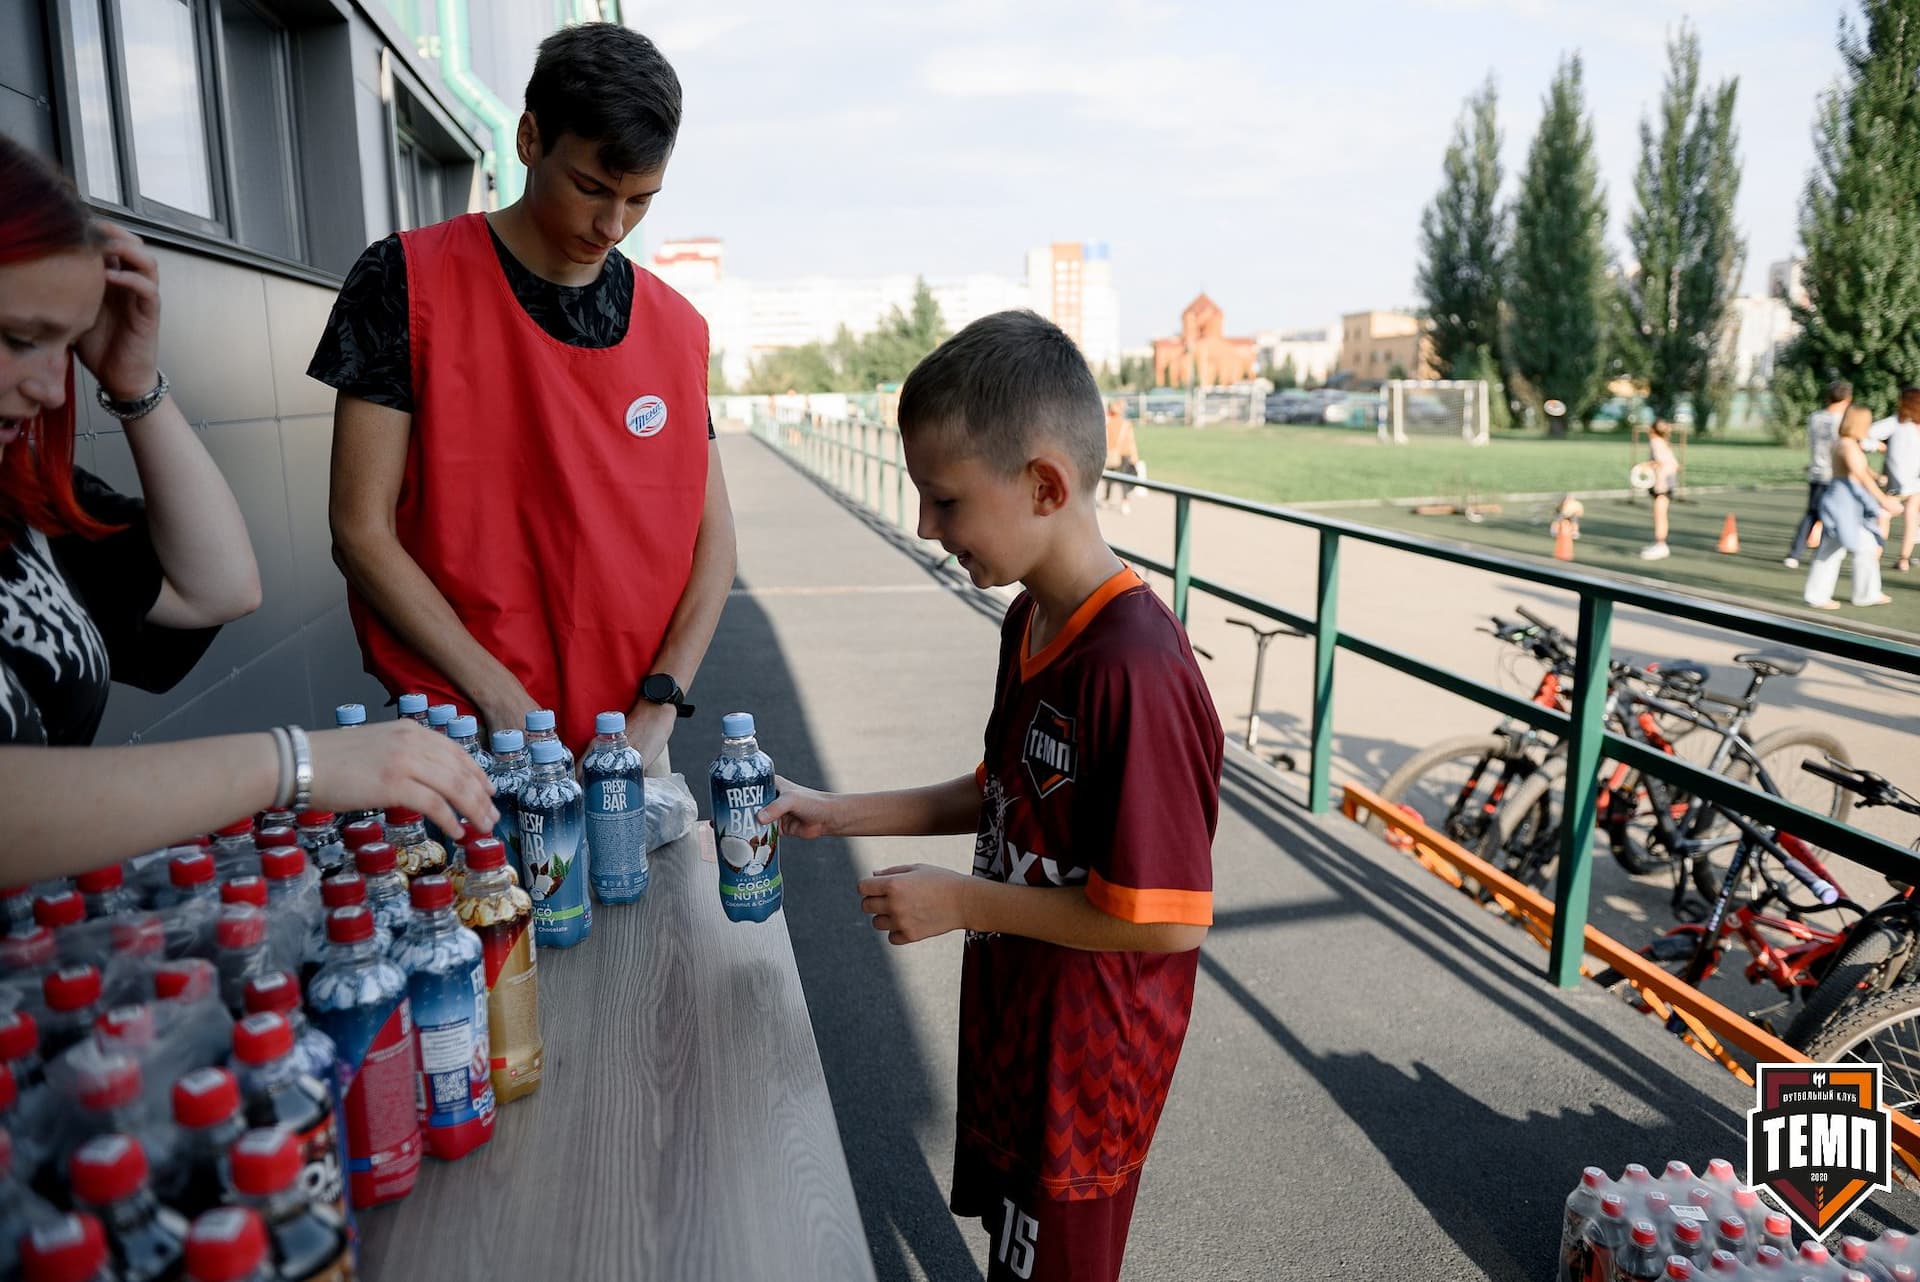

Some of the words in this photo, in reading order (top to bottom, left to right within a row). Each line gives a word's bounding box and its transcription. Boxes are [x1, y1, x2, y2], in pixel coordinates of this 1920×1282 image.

[1029, 729, 1070, 772] ТЕМП
[602, 780, 627, 794] FRESH
[726, 785, 764, 808] FRESH
[602, 793, 628, 812] BAR
[733, 886, 774, 901] NUTTY
[737, 878, 771, 891] COCO
[998, 1197, 1039, 1280] 15
